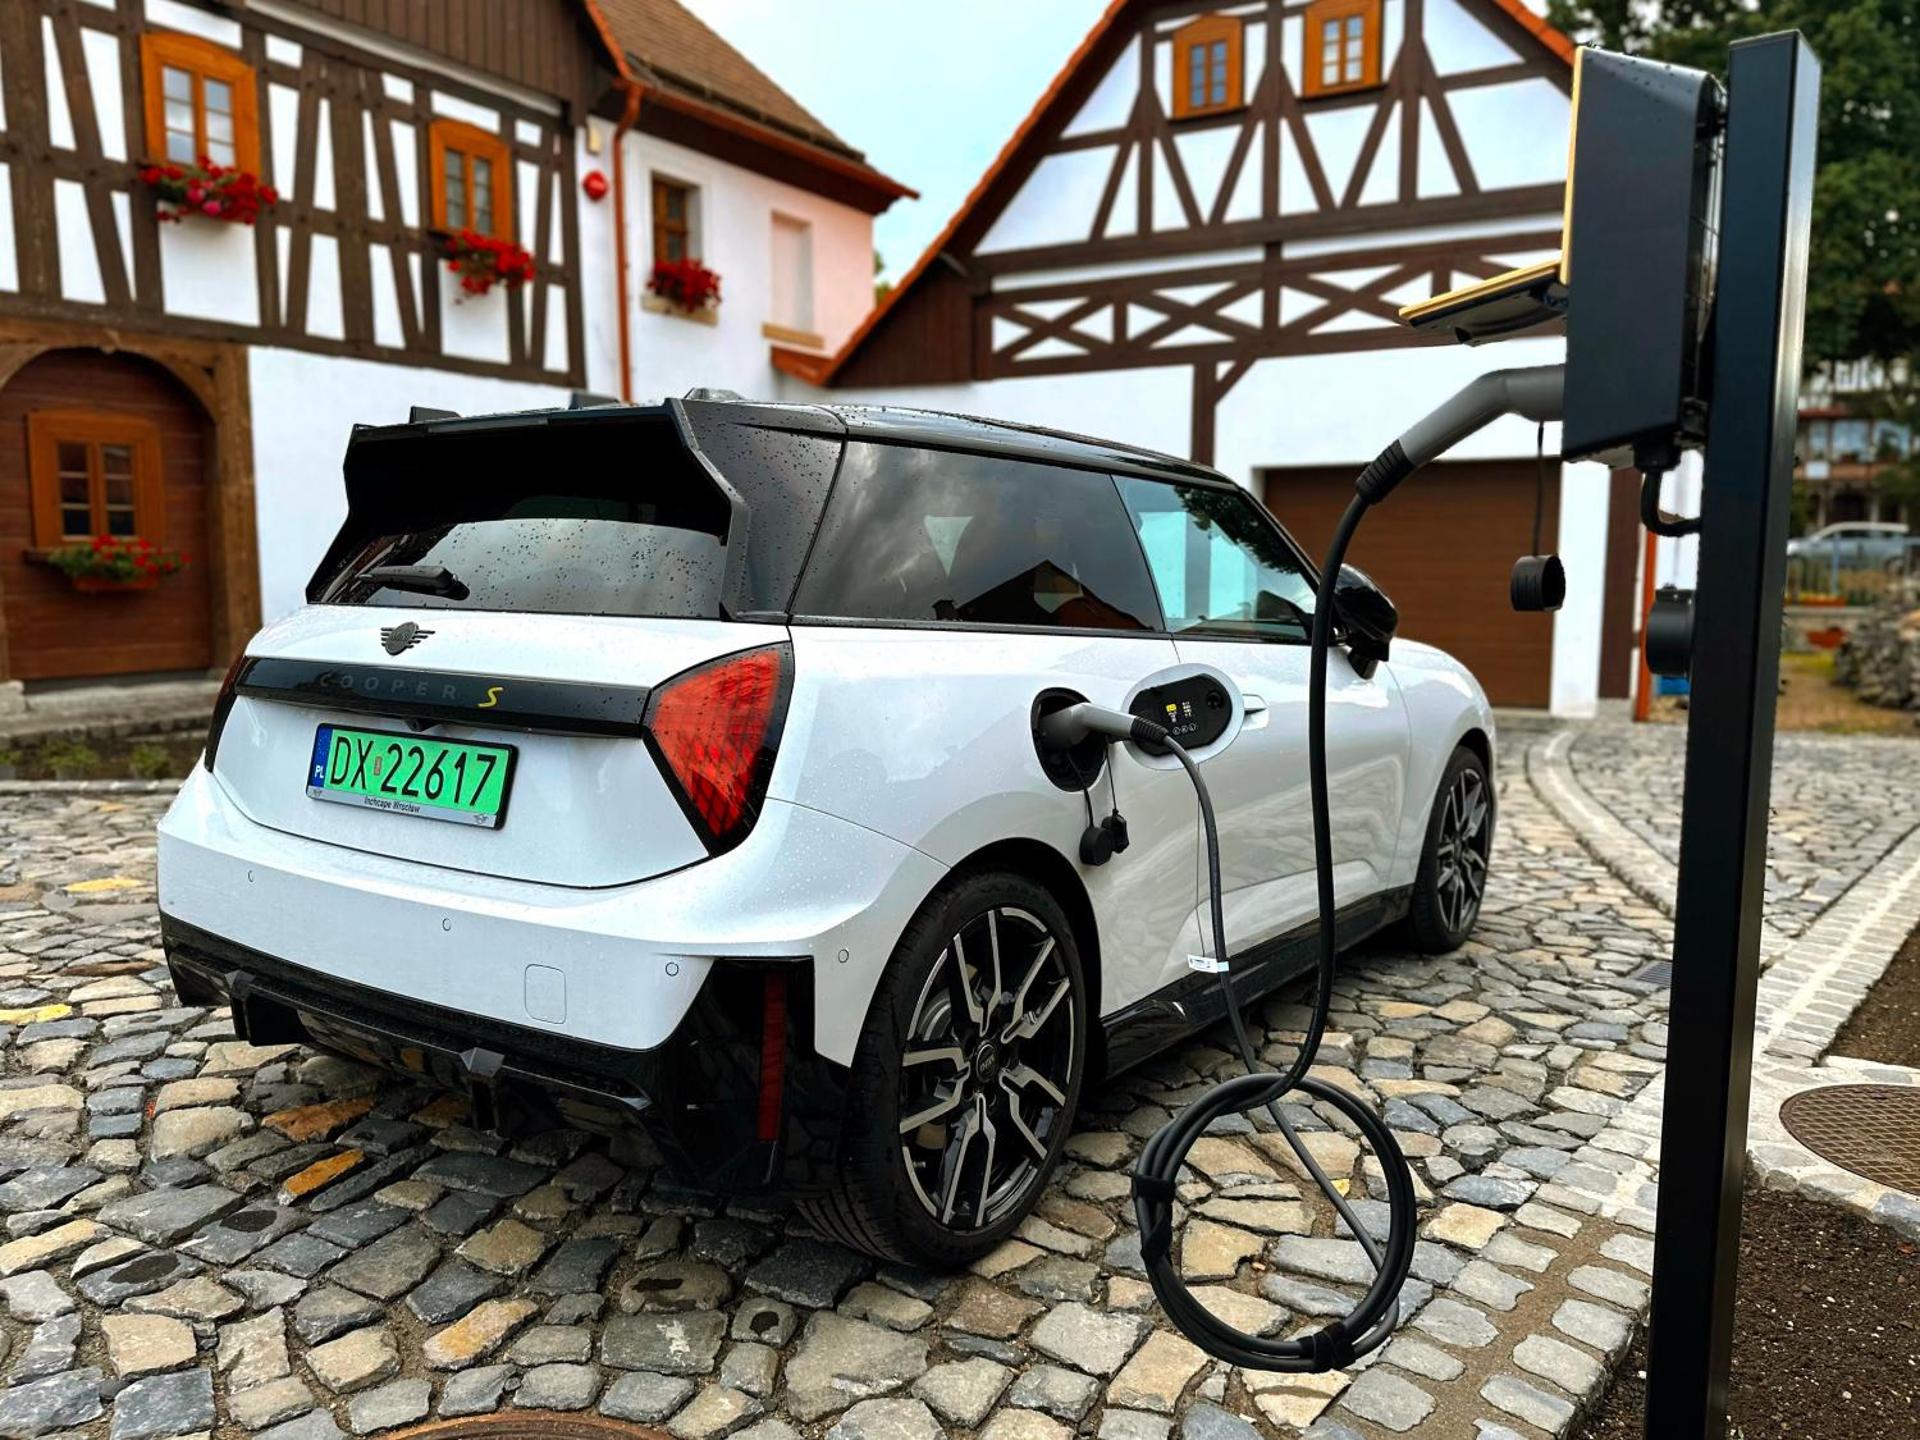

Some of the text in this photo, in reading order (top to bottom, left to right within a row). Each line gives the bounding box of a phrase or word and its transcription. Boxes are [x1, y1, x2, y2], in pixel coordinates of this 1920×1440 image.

[320, 673, 504, 708] COOPER S
[314, 764, 325, 779] PL
[330, 736, 498, 807] DX 22617
